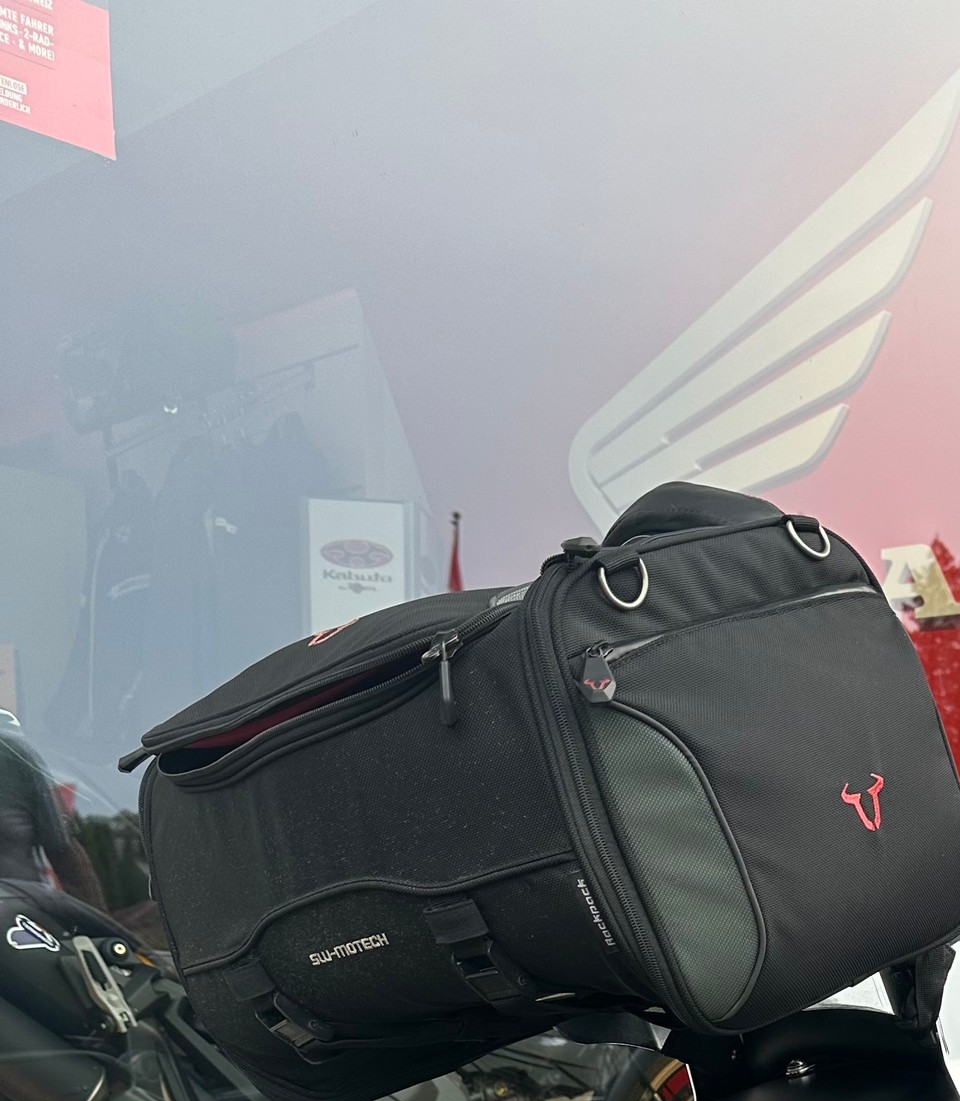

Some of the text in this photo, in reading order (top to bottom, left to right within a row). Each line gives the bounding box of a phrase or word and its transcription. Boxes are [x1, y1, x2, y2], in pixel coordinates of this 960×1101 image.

[20, 13, 54, 36] FAHRER
[18, 38, 26, 50] &
[28, 42, 55, 62] MORE!
[577, 879, 616, 946] Rackpack
[309, 933, 390, 966] SW-MOTECH
